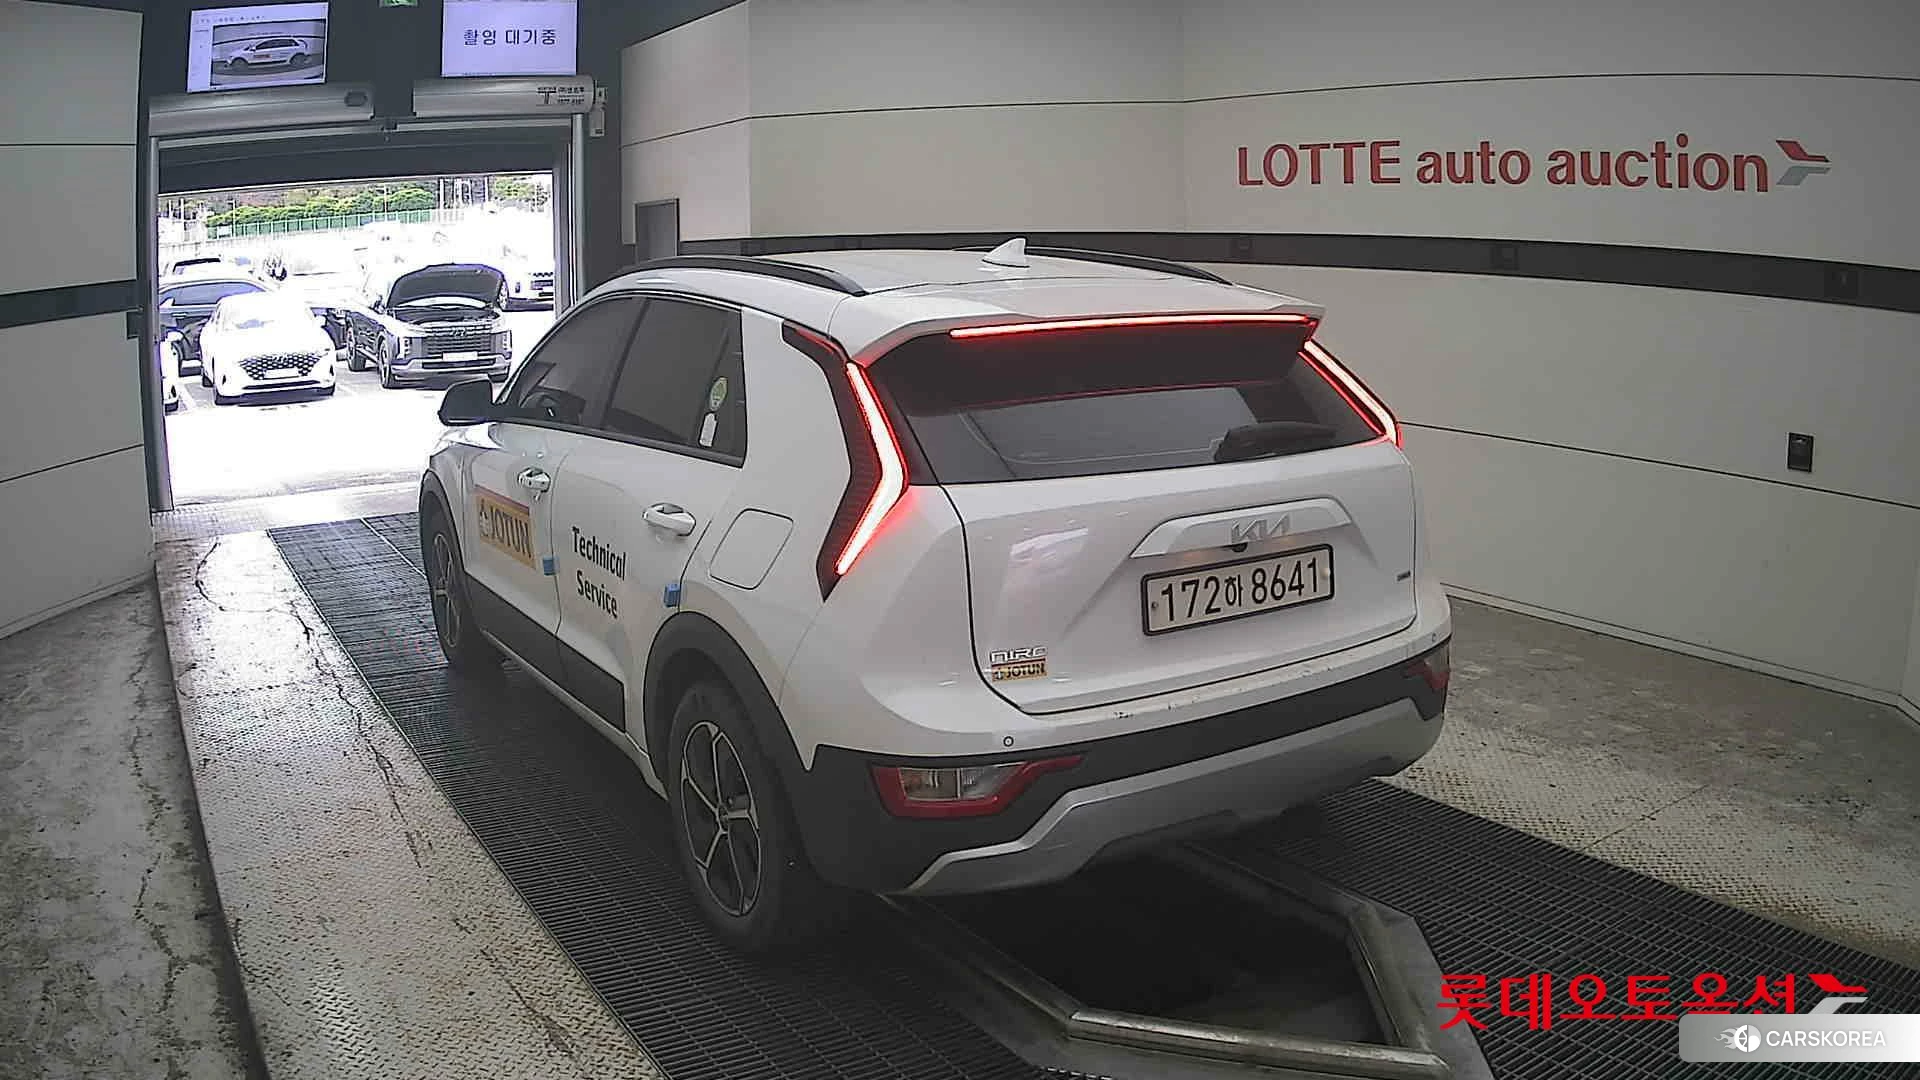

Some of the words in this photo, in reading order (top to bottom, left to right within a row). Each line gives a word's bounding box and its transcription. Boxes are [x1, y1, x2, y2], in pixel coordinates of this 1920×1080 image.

[505, 29, 557, 46] 대기중
[1237, 140, 1401, 187] LOTTE
[1416, 141, 1531, 186] auto
[1546, 133, 1769, 193] auction
[490, 506, 531, 558] JOTUN
[572, 526, 626, 582] Technical
[576, 570, 618, 619] Service
[1161, 574, 1243, 621] 172하
[1251, 556, 1318, 605] 8641
[1007, 663, 1045, 678] JOTUN
